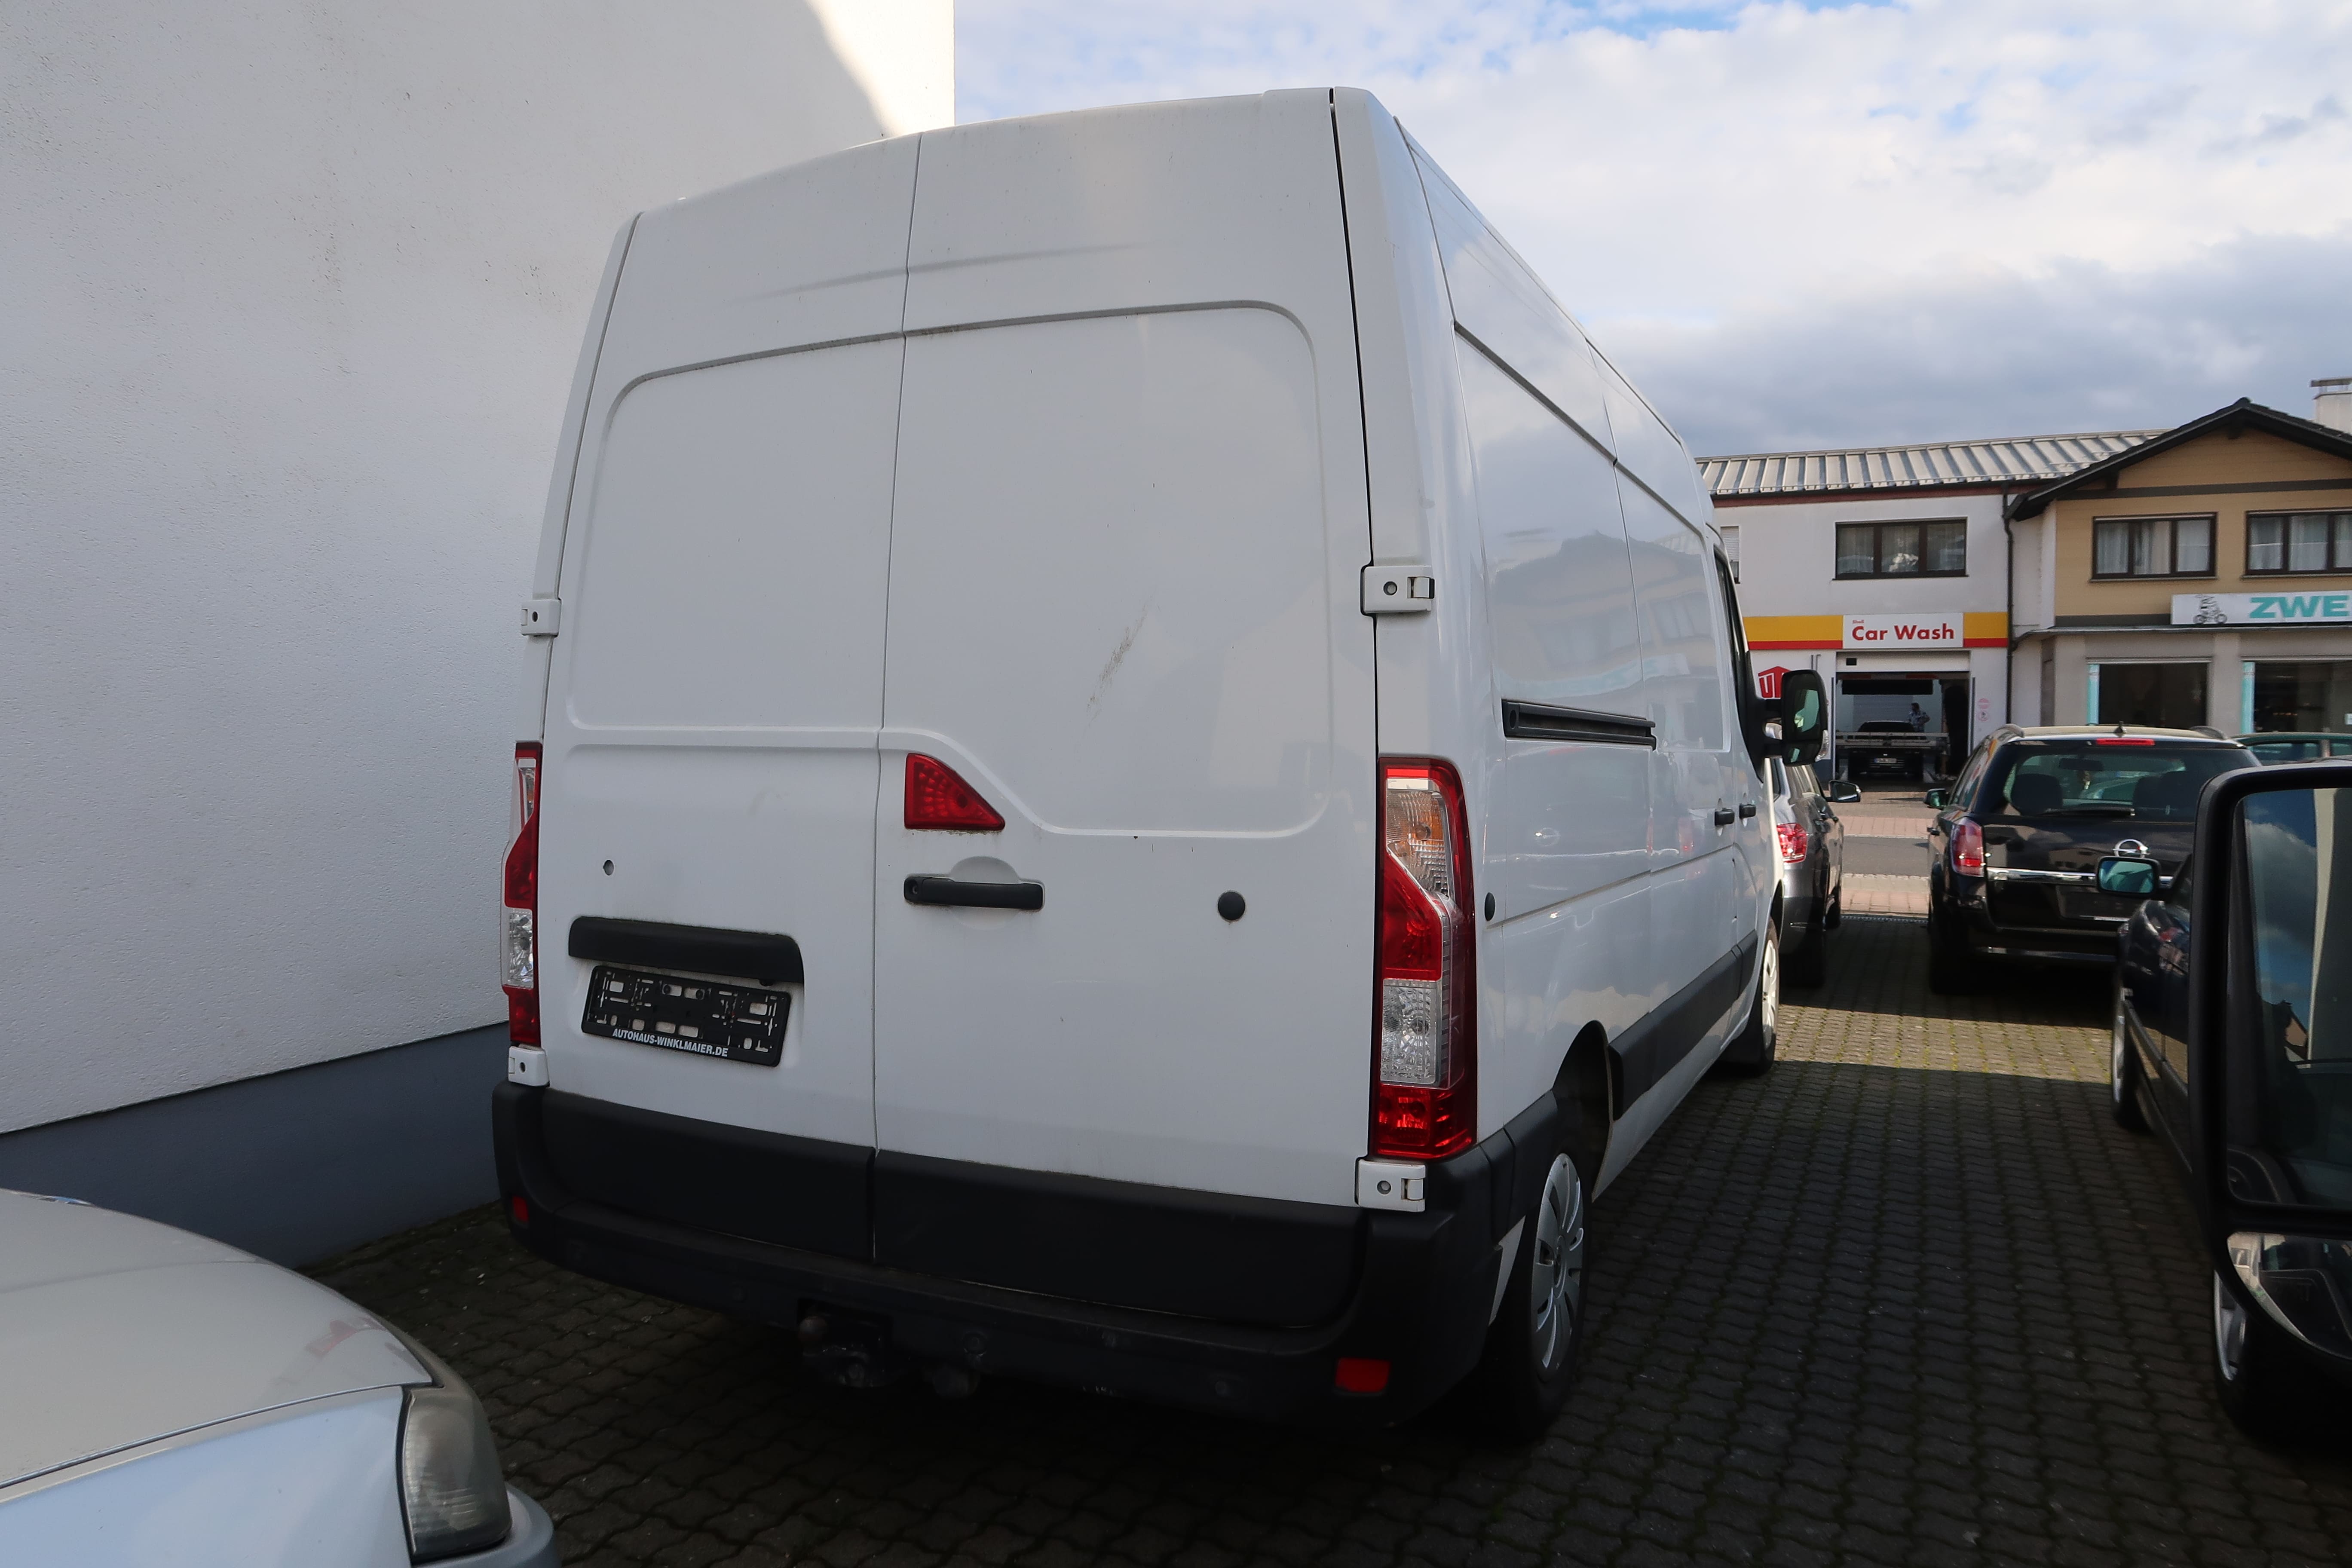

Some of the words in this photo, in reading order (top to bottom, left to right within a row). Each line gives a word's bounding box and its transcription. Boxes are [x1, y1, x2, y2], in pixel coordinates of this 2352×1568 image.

[1852, 625, 1888, 640] Car
[1894, 623, 1954, 640] Wash
[612, 1028, 729, 1057] AUTOHAUS-WINKLMAIER.DE
